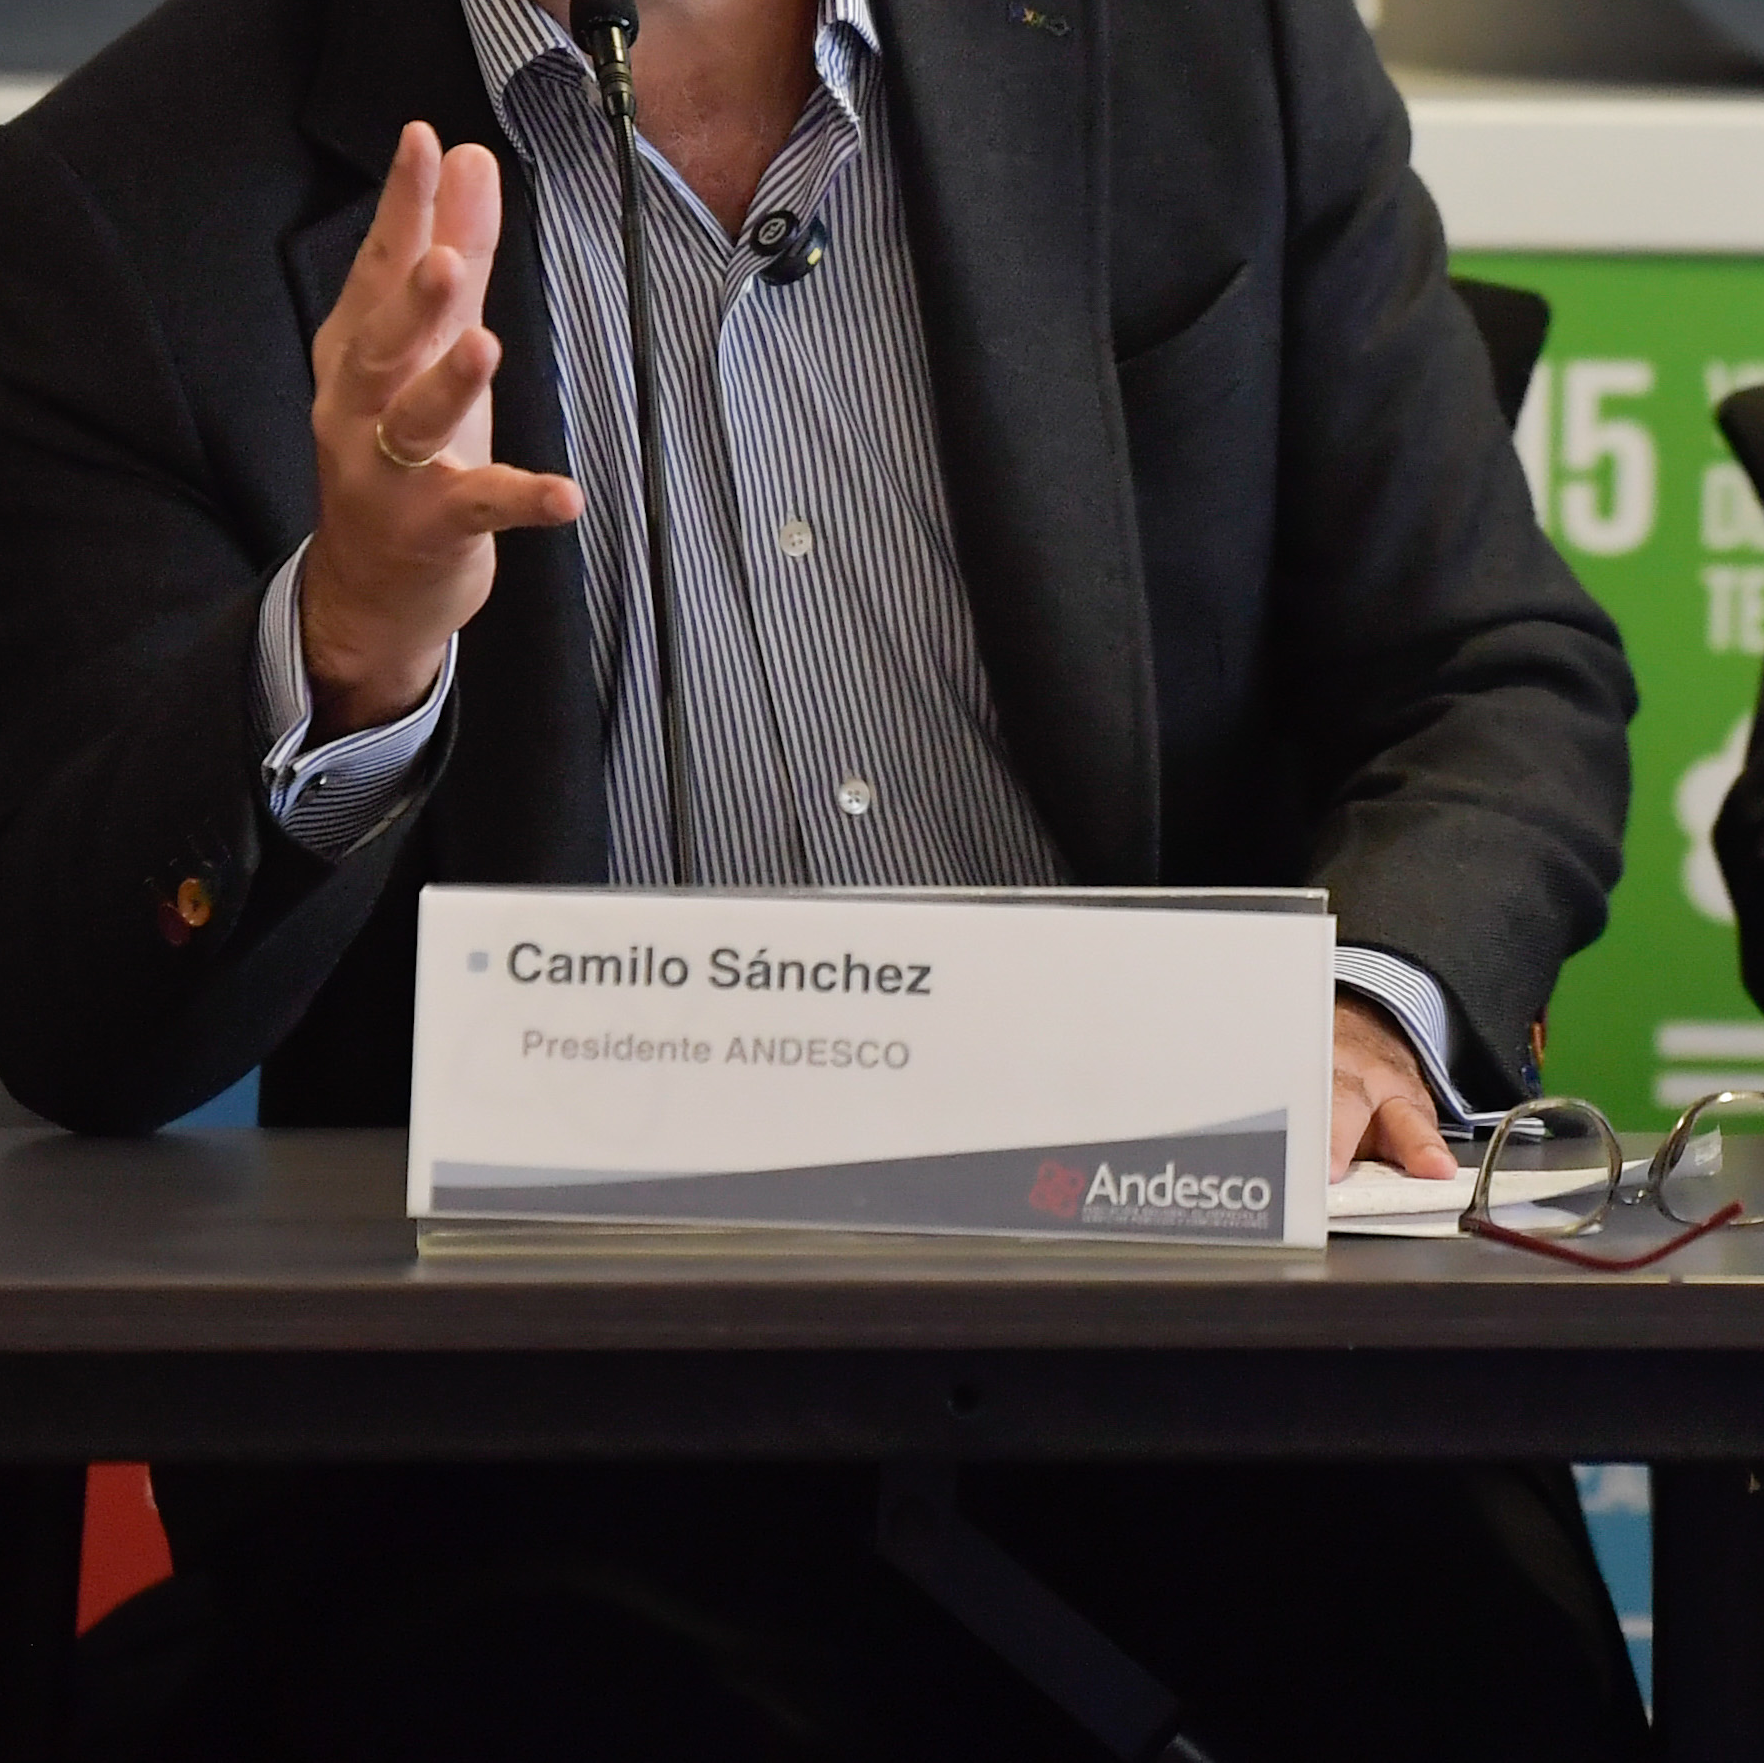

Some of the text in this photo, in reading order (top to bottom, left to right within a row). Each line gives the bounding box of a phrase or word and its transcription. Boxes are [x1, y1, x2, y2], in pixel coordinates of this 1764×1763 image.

[506, 941, 932, 996] Camilo Sánchez
[521, 1028, 912, 1071] Presidente ANDESCO
[1085, 1162, 1271, 1210] Andesco
